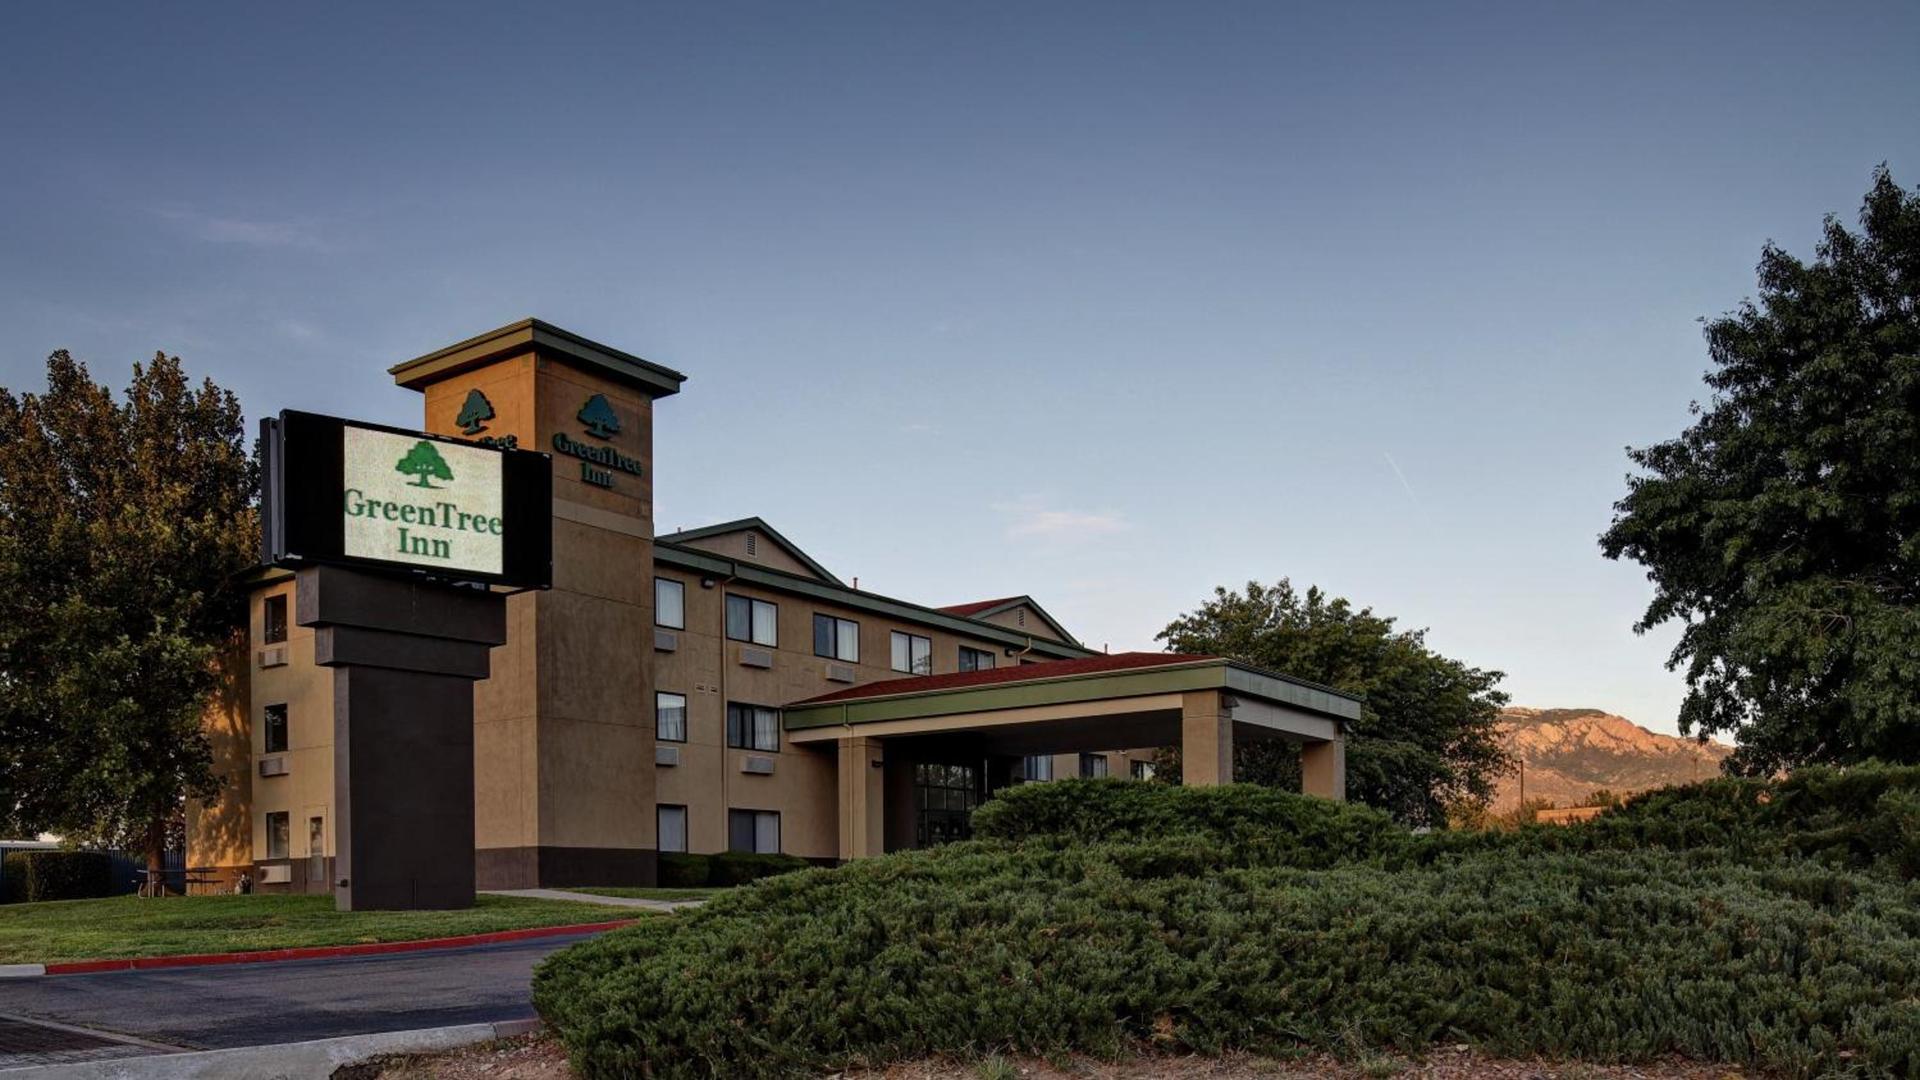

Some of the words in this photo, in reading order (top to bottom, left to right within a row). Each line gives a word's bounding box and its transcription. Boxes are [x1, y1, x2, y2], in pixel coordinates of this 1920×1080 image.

[553, 432, 643, 476] GreenTree
[580, 461, 615, 489] Inn
[344, 488, 503, 536] GreenTree
[397, 527, 451, 559] Inn
